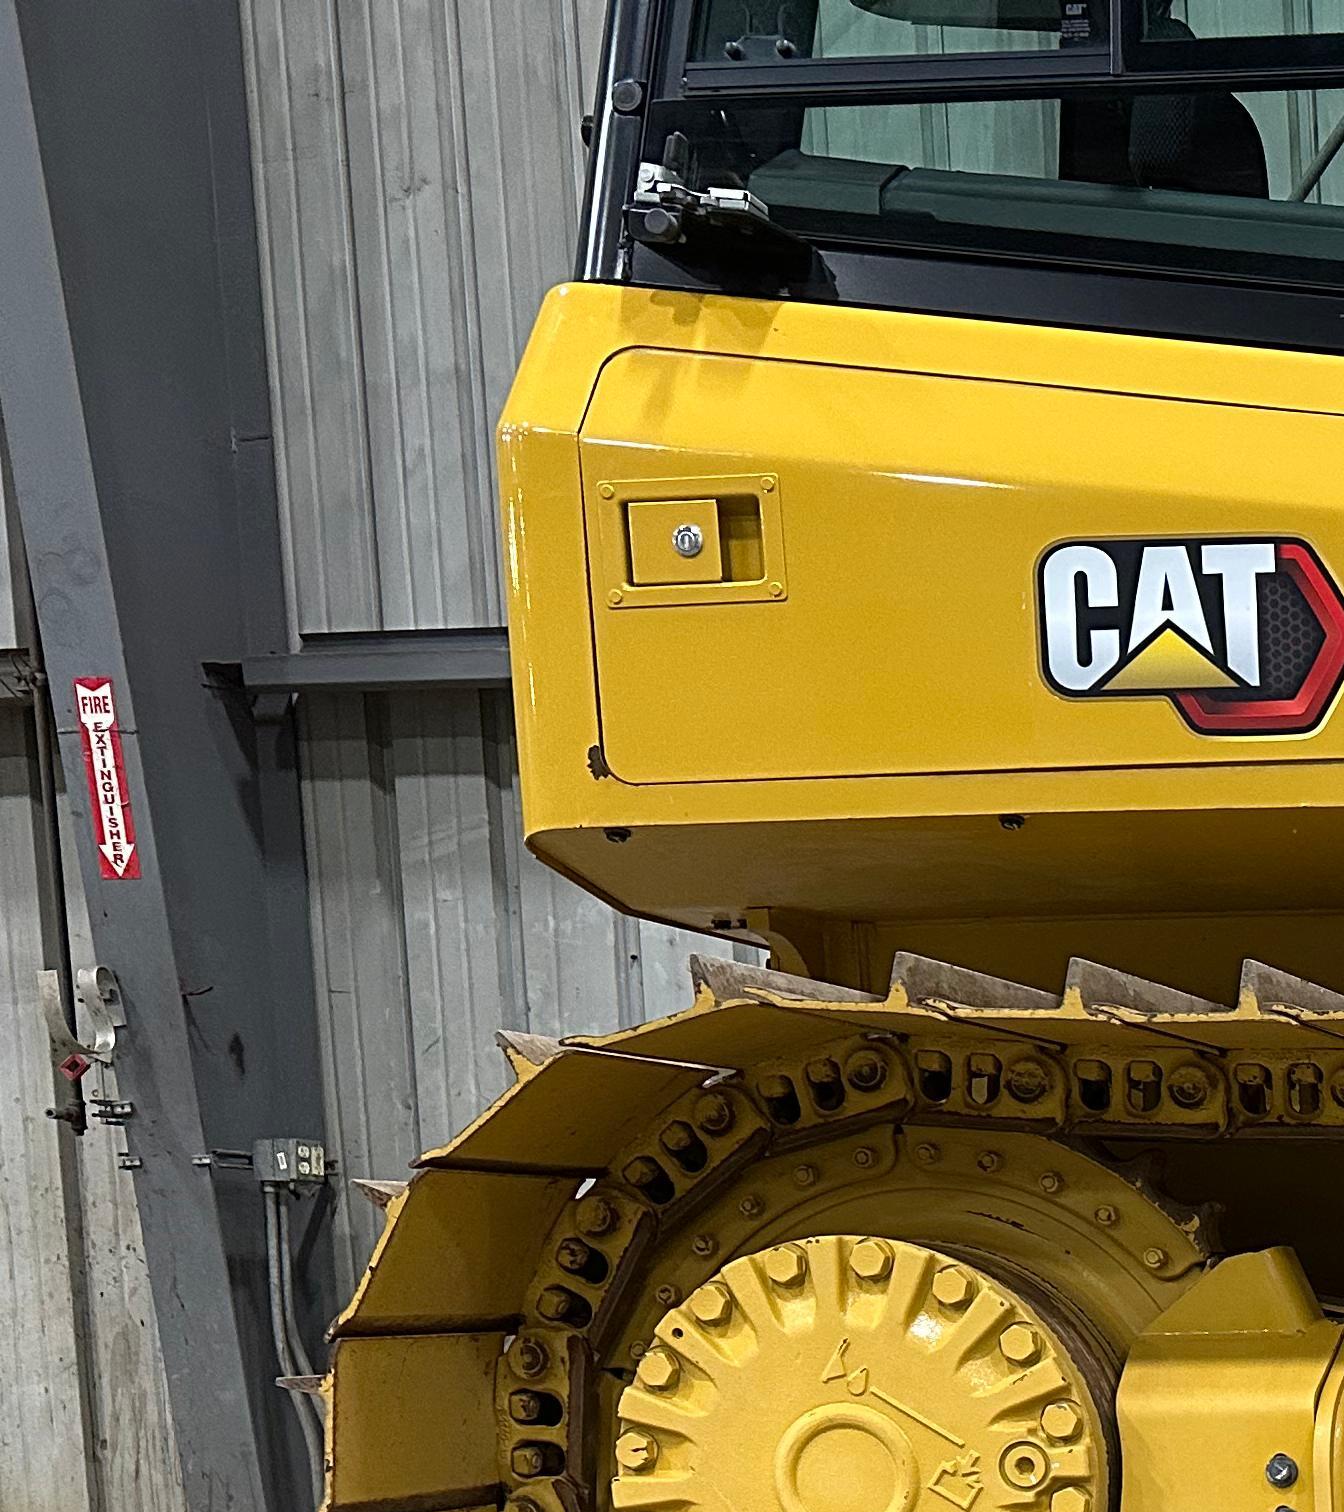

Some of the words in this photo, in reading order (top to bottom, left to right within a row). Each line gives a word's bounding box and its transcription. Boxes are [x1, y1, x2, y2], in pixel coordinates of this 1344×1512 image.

[1043, 543, 1276, 690] CAT
[80, 695, 111, 714] FIRE
[93, 721, 125, 867] EXTINGUISHER
